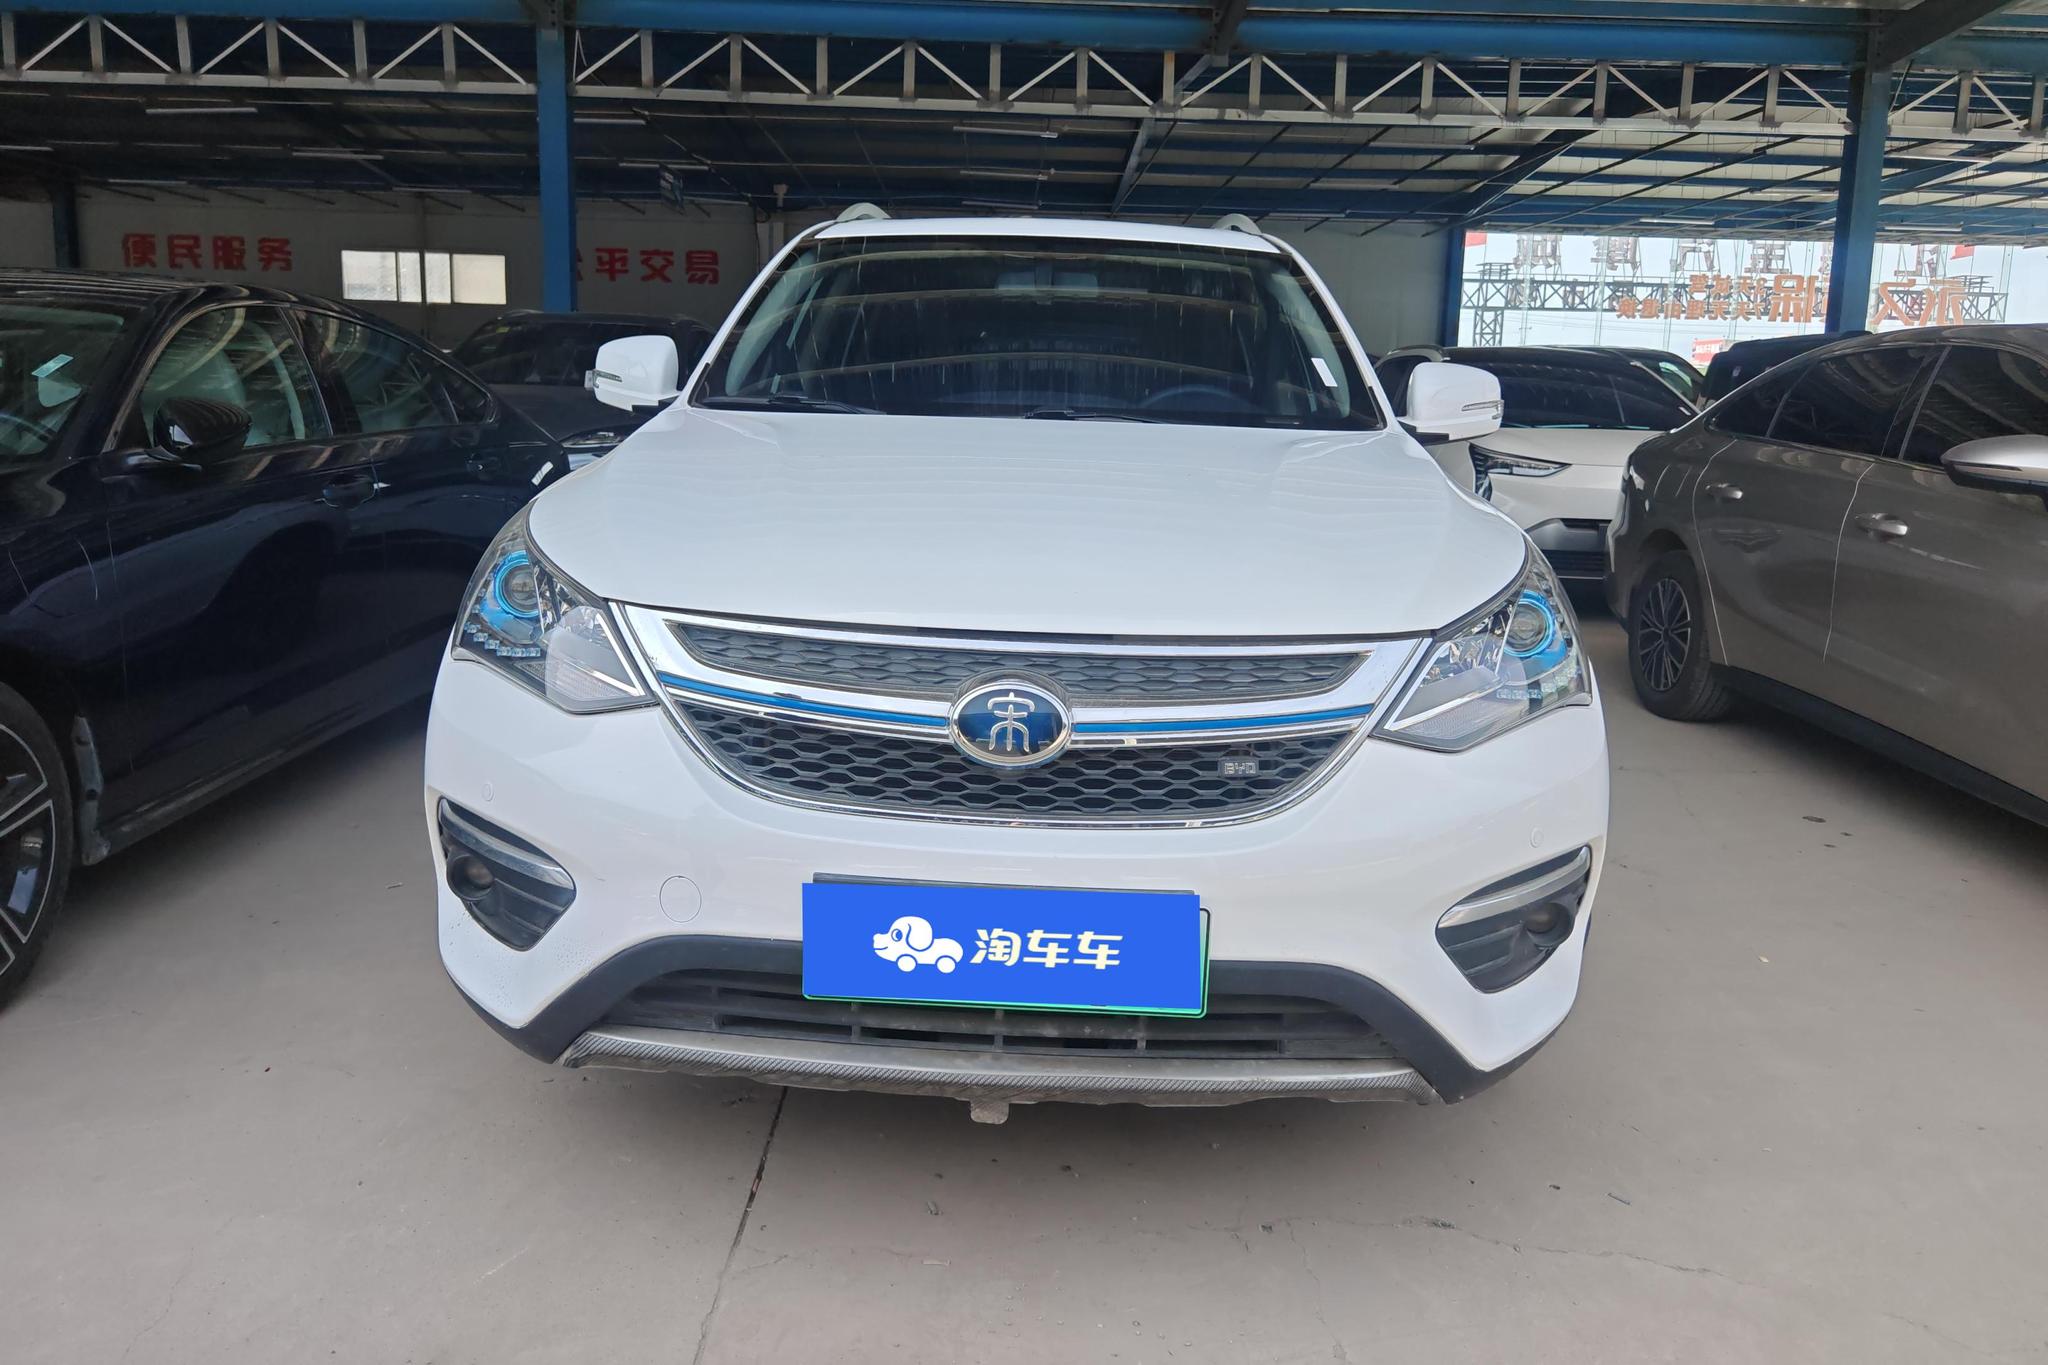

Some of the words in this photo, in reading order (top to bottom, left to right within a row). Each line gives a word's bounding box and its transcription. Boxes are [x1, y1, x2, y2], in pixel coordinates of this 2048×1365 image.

[122, 233, 292, 271] 便民服务
[1224, 762, 1256, 775] BYD
